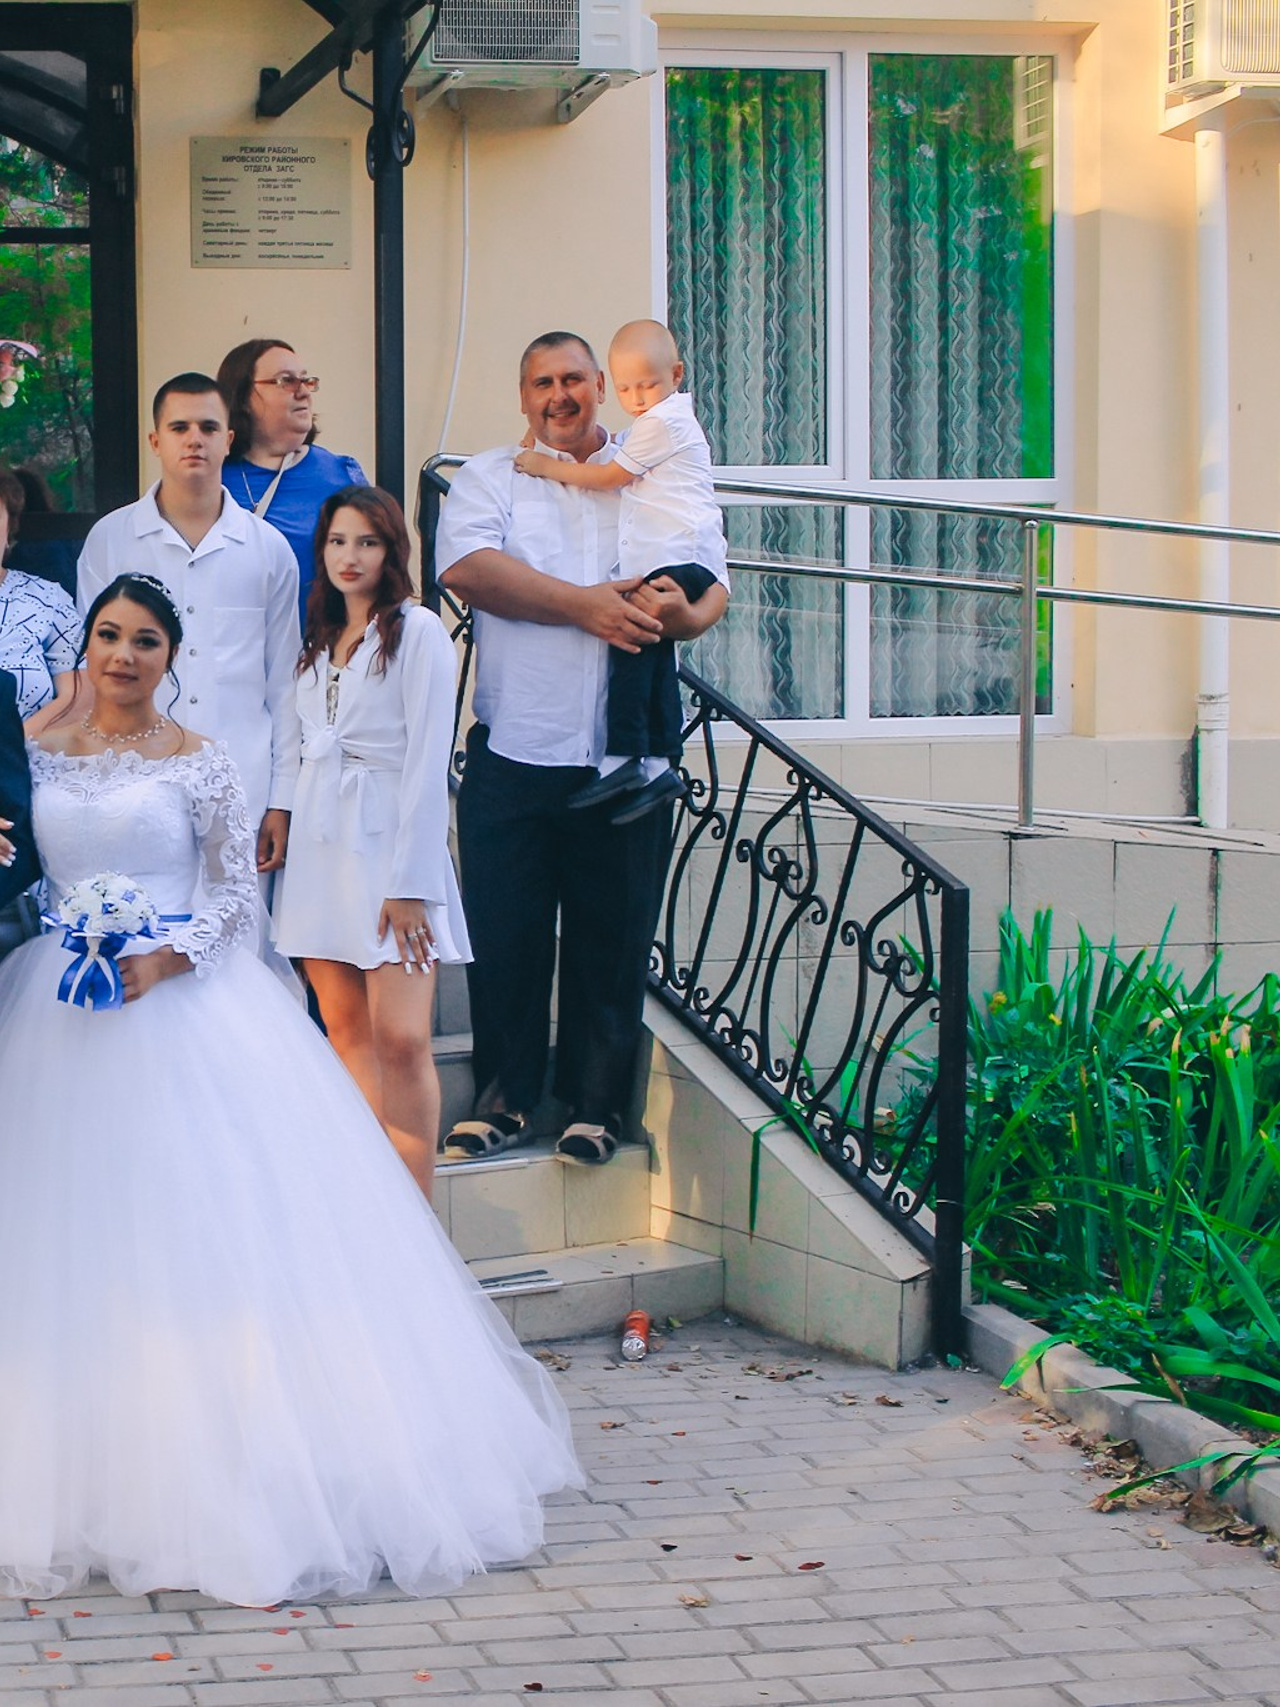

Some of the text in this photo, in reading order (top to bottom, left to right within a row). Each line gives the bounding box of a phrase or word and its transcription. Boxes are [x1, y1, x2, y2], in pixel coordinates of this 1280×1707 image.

[239, 146, 299, 154] РЕЖИМ РАБОТЫ
[221, 155, 317, 164] КИРОВСКОГО РАЙОННОГО
[243, 164, 295, 173] ОТДЕЛА ЗАГС
